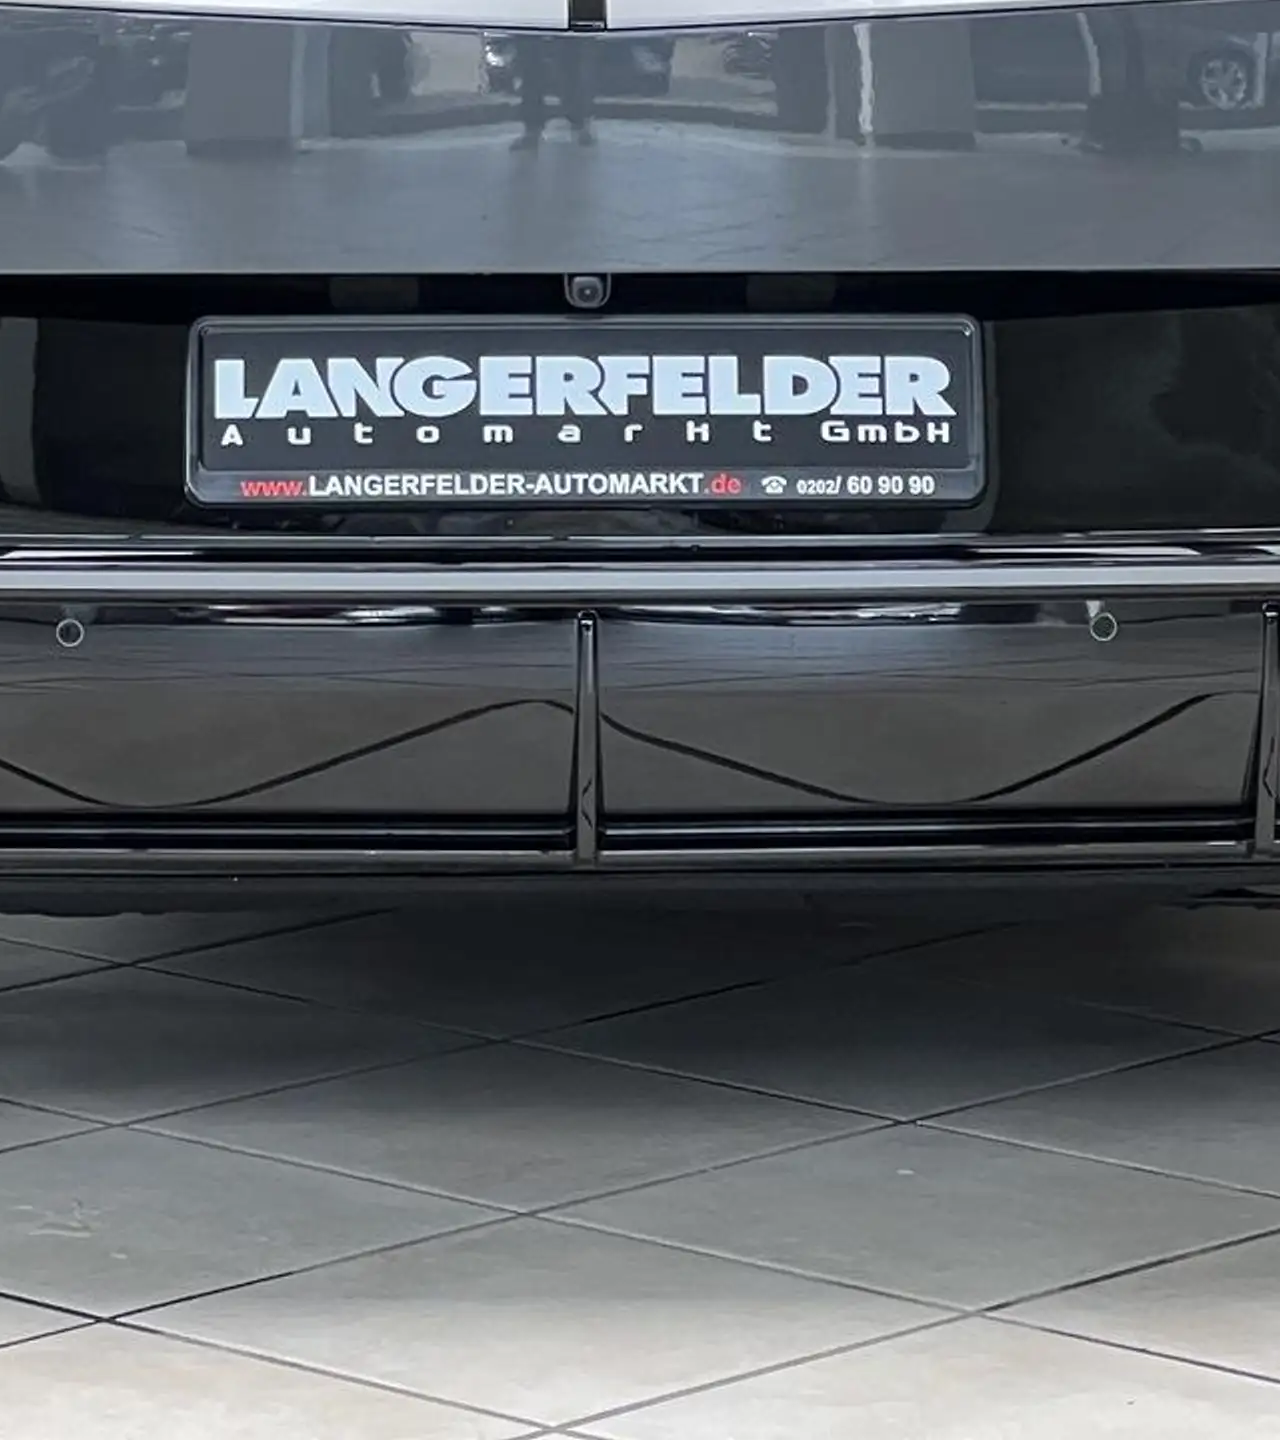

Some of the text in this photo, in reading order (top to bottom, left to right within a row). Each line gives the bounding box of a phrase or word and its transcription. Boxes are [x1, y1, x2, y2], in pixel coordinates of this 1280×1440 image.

[214, 356, 957, 419] LANGERFELDER
[820, 420, 951, 444] GmbH
[240, 472, 742, 498] www.LANGERFELDER-AUTOMARKT.de
[847, 475, 872, 495] 60
[877, 475, 903, 495] 90
[909, 475, 935, 495] 90
